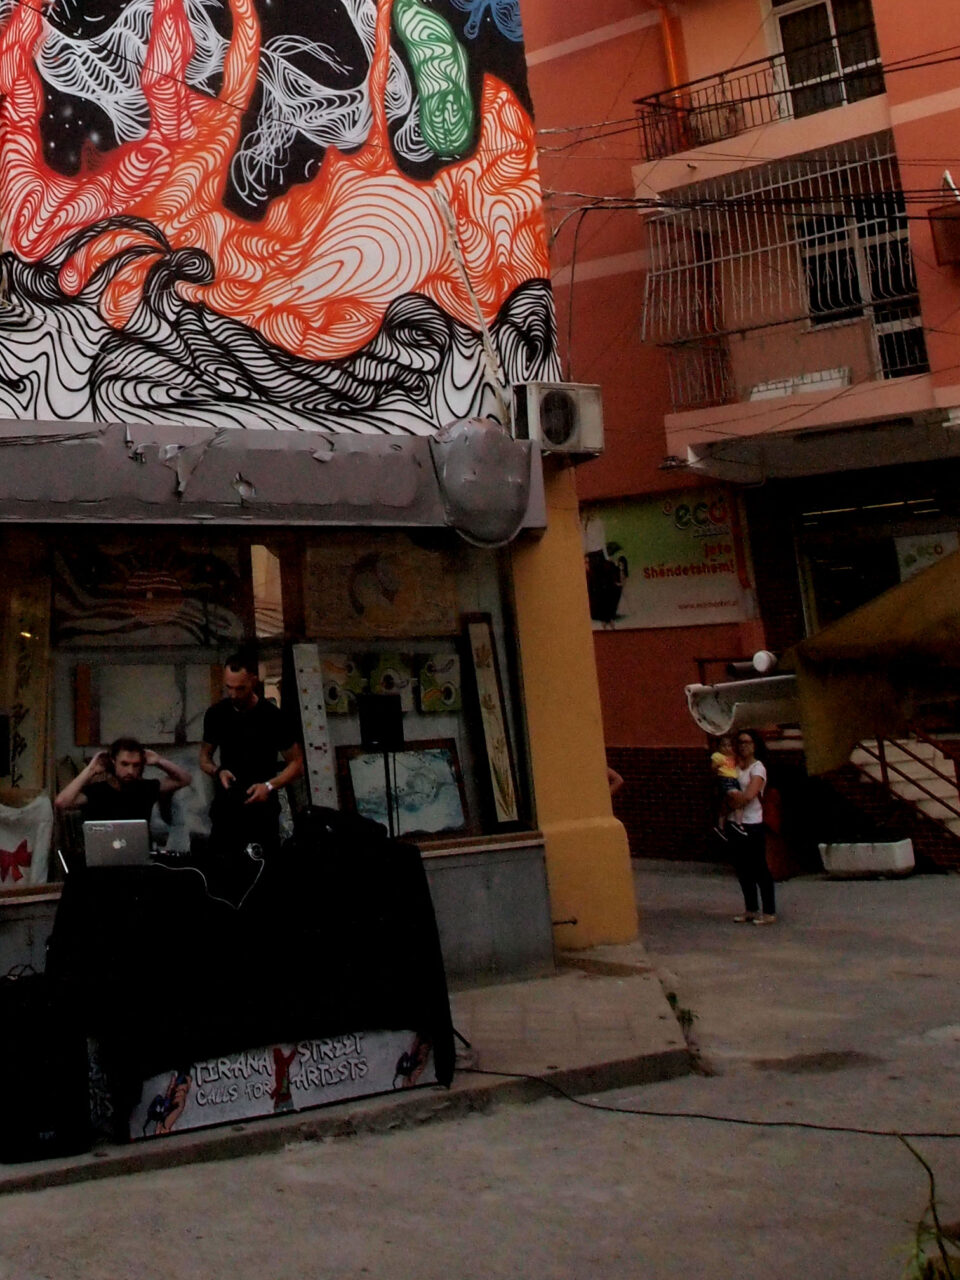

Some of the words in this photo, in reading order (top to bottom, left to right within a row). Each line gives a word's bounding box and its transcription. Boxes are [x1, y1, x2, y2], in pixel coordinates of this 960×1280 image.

[193, 1048, 272, 1087] TIRANA
[295, 1032, 363, 1063] STREET
[196, 1085, 239, 1107] CALLS
[245, 1080, 275, 1101] FOR
[290, 1058, 368, 1091] ARTISTS
